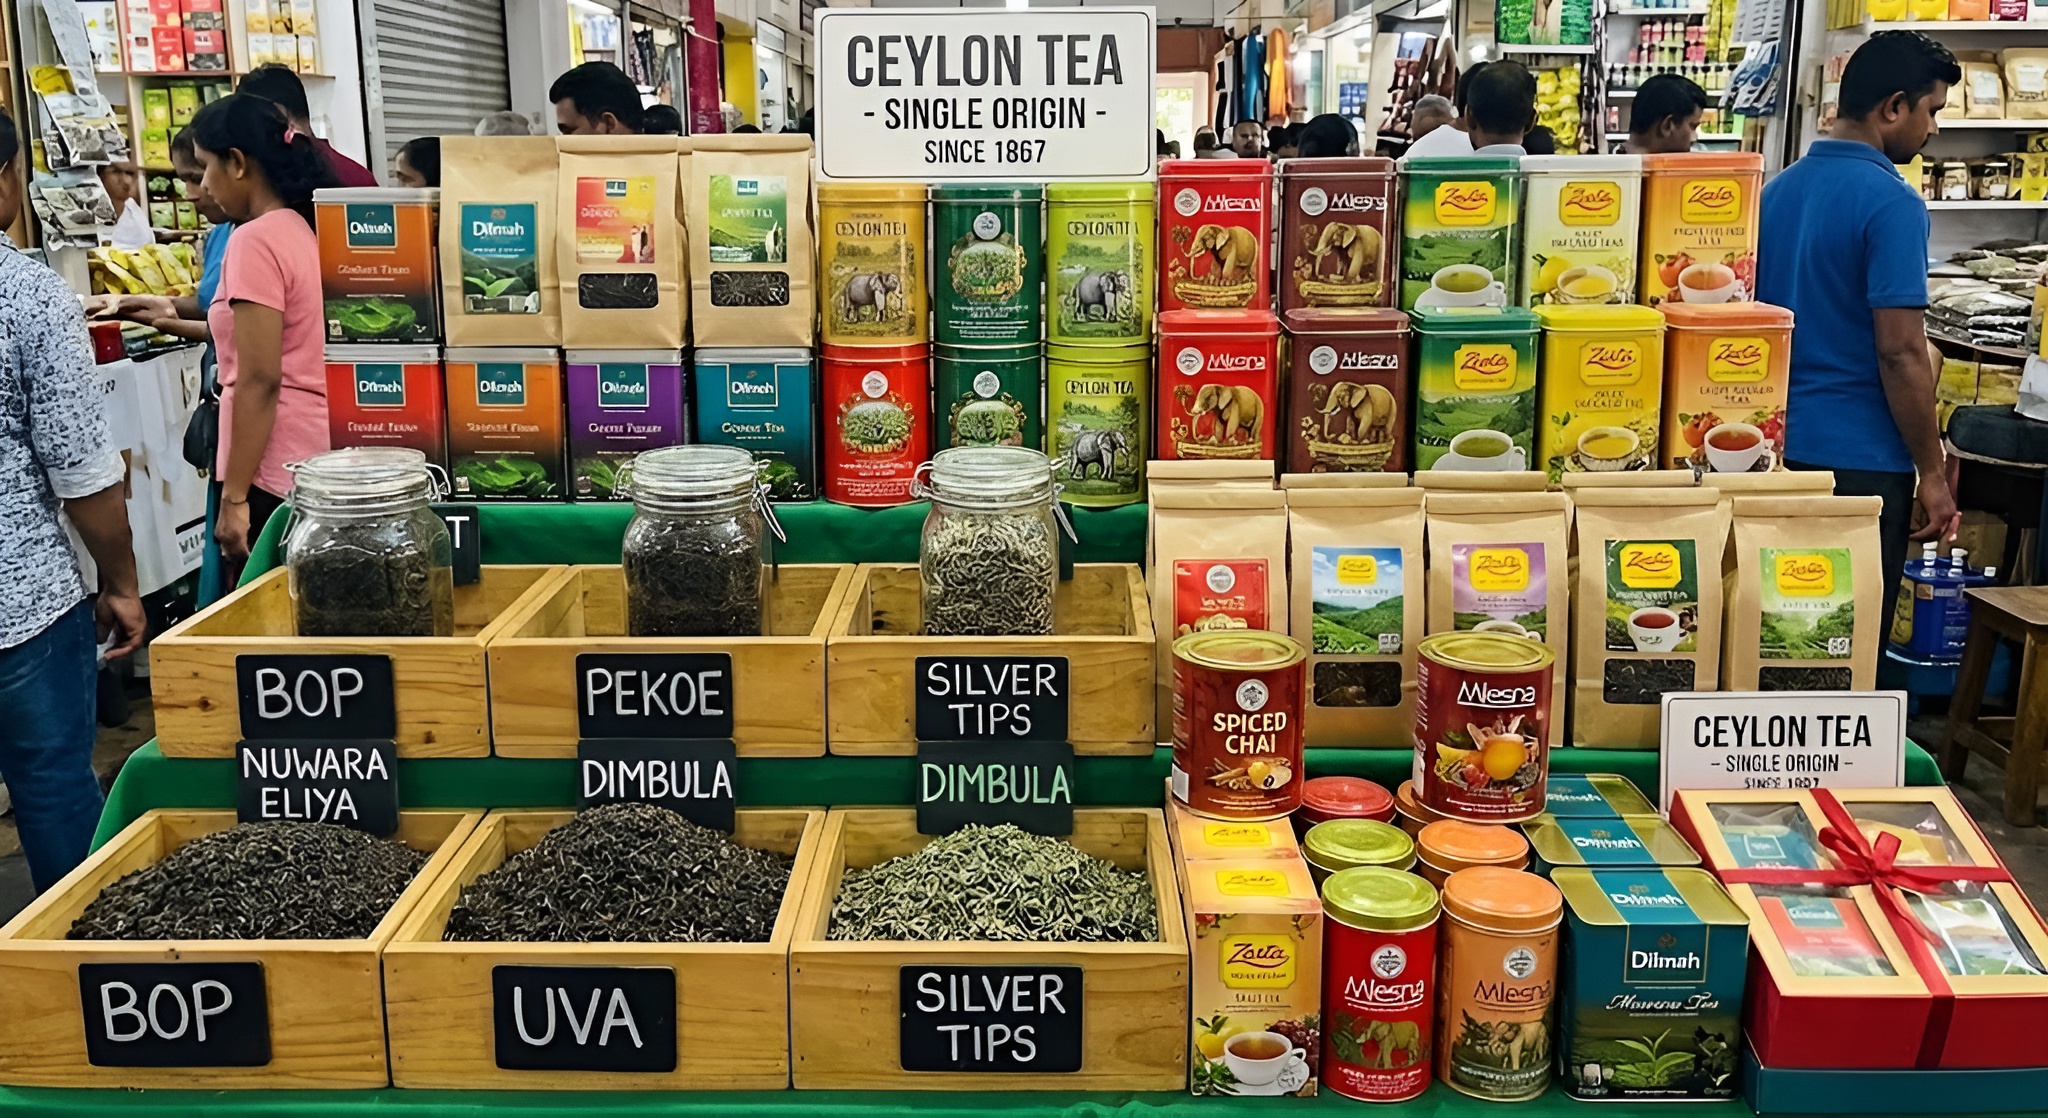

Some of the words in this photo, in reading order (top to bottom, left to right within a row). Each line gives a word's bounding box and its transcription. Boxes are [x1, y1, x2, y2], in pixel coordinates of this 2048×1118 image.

[848, 35, 1021, 87] CEYLON
[1037, 35, 1123, 85] TEA
[885, 98, 982, 129] SINGLE
[993, 98, 1085, 128] ORIGIN
[925, 140, 985, 163] SINCE
[996, 140, 1045, 163] 1867
[256, 668, 363, 718] BOP
[587, 668, 723, 715] PEKOE
[928, 663, 1057, 696] SILVER
[1457, 681, 1536, 706] Mlesna
[948, 703, 1031, 735] TIPS
[1214, 712, 1286, 733] SPICED
[1694, 715, 1806, 747] CEYLON
[1817, 715, 1871, 746] TEA
[1226, 734, 1275, 754] CHAI
[243, 748, 388, 779] NUWARA
[583, 760, 732, 798] DIMBULA
[1726, 755, 1780, 772] SINGLE
[1786, 754, 1838, 771] ORIGIN
[922, 764, 1071, 804] DIMBULA
[262, 788, 357, 823] ELIYA
[1631, 951, 1700, 969] Dilmah
[917, 973, 1065, 1013] SILVER
[101, 980, 232, 1041] BOP
[514, 987, 643, 1048] UVA
[937, 1024, 1036, 1061] TIPS
